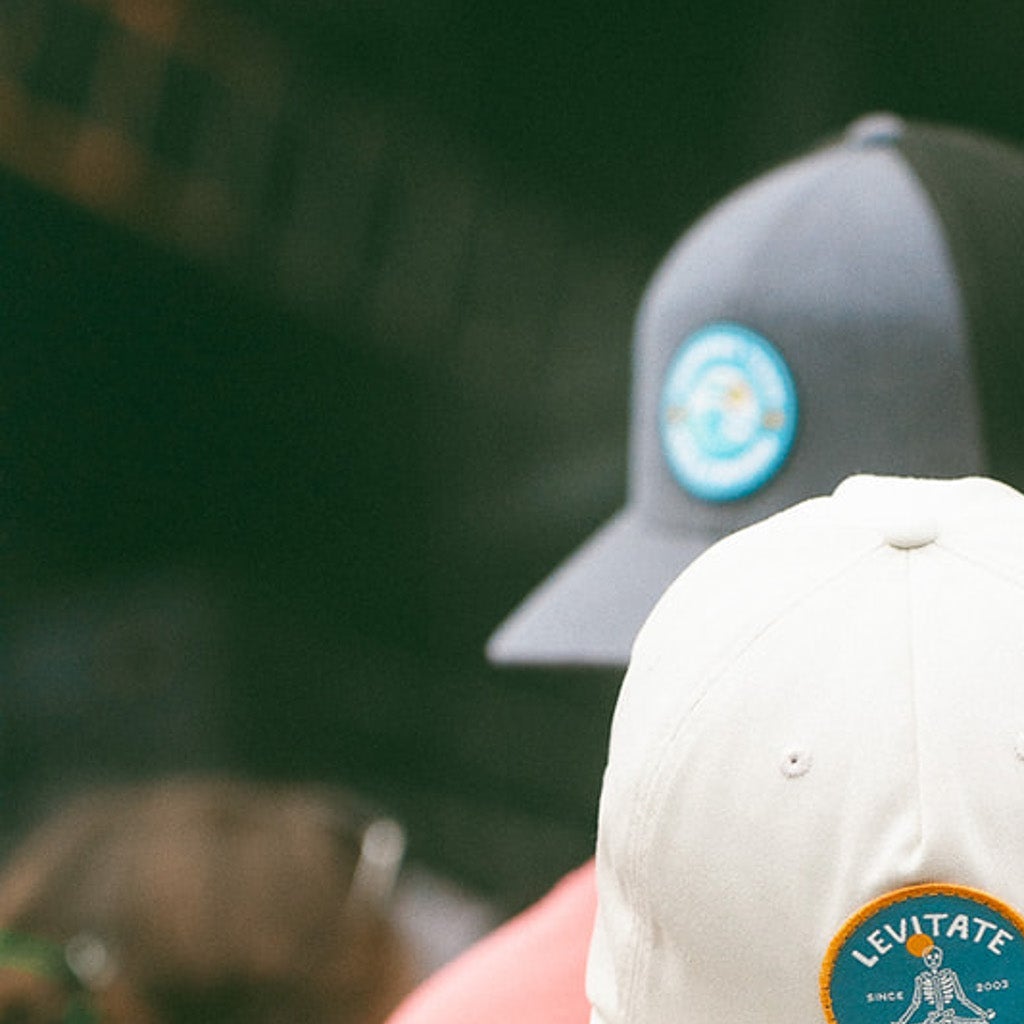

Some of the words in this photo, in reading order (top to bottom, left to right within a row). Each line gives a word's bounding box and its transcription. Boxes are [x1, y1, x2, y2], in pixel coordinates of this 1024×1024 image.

[851, 913, 1014, 968] LEVITATE
[866, 991, 904, 1002] SINCE
[976, 980, 1009, 992] 2003
